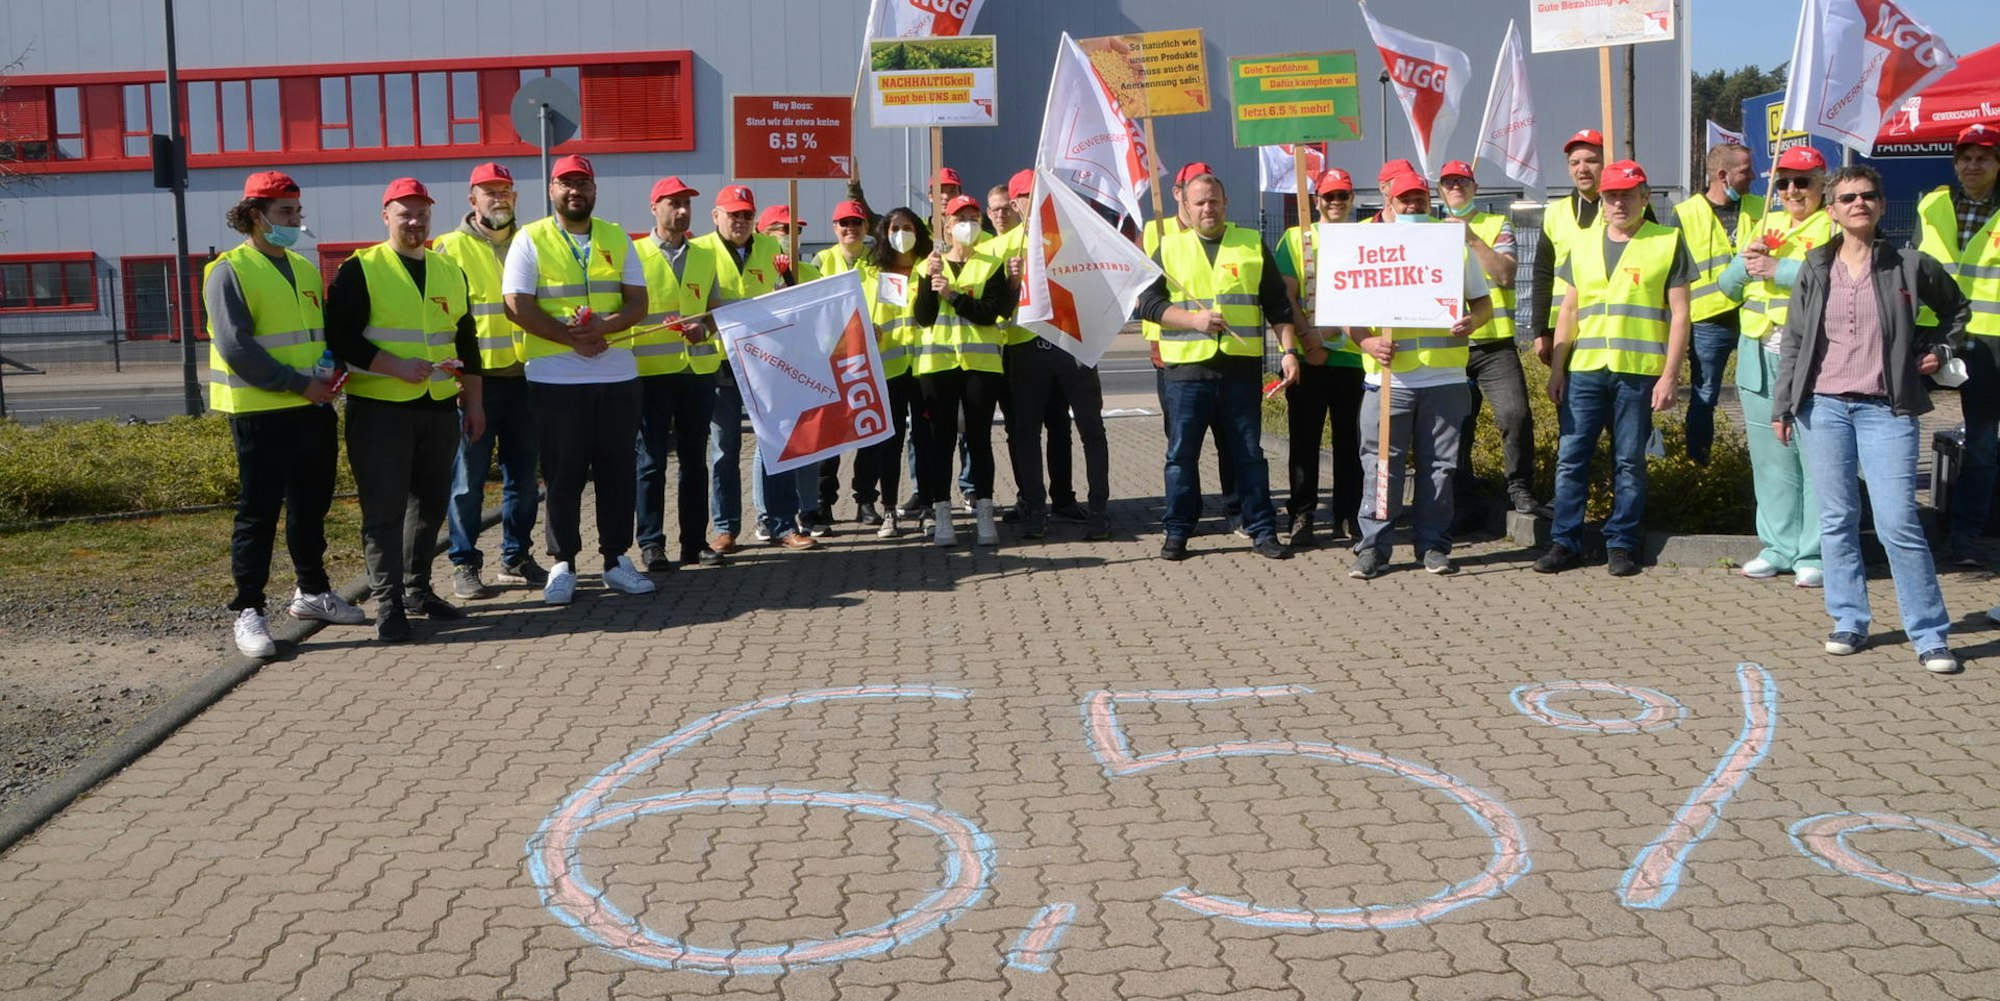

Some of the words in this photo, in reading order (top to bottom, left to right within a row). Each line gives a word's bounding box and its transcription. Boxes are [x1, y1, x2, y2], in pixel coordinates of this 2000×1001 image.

[1537, 2, 1560, 13] Gute
[1871, 2, 1938, 68] NGG
[1129, 42, 1141, 52] So
[1142, 38, 1181, 50] natürlich
[1181, 38, 1198, 47] wie
[1130, 54, 1159, 65] unsere
[1160, 50, 1199, 61] Produkte
[1138, 66, 1161, 77] muss
[1162, 63, 1185, 74] auch
[1185, 63, 1200, 72] die
[1243, 64, 1264, 75] Gute
[1393, 58, 1445, 93] NGG
[881, 75, 971, 89] NACHHALTIGkeit
[1120, 78, 1178, 91] Anerkennung
[1179, 75, 1201, 86] sein!
[911, 90, 928, 102] bei
[928, 90, 950, 102] UNS
[950, 90, 968, 101] an!
[772, 101, 789, 111] Hey
[790, 101, 814, 110] Boss:
[1243, 106, 1267, 118] Jetzt
[1268, 104, 1286, 118] 6,5
[1288, 104, 1298, 115] %
[1299, 102, 1331, 115] mehr!
[746, 117, 766, 126] Sind
[767, 117, 781, 126] wir
[782, 117, 795, 126] dir
[795, 118, 816, 126] etwa
[816, 117, 840, 126] keine
[1932, 108, 1980, 121] GEWERKSCHAFT
[768, 132, 798, 150] 6,5
[802, 133, 818, 149] %
[780, 155, 799, 164] wert
[799, 155, 806, 163] ?
[1357, 243, 1407, 265] Jetzt
[743, 341, 837, 400] GEWERKSCHAFT
[836, 353, 883, 438] NGG
